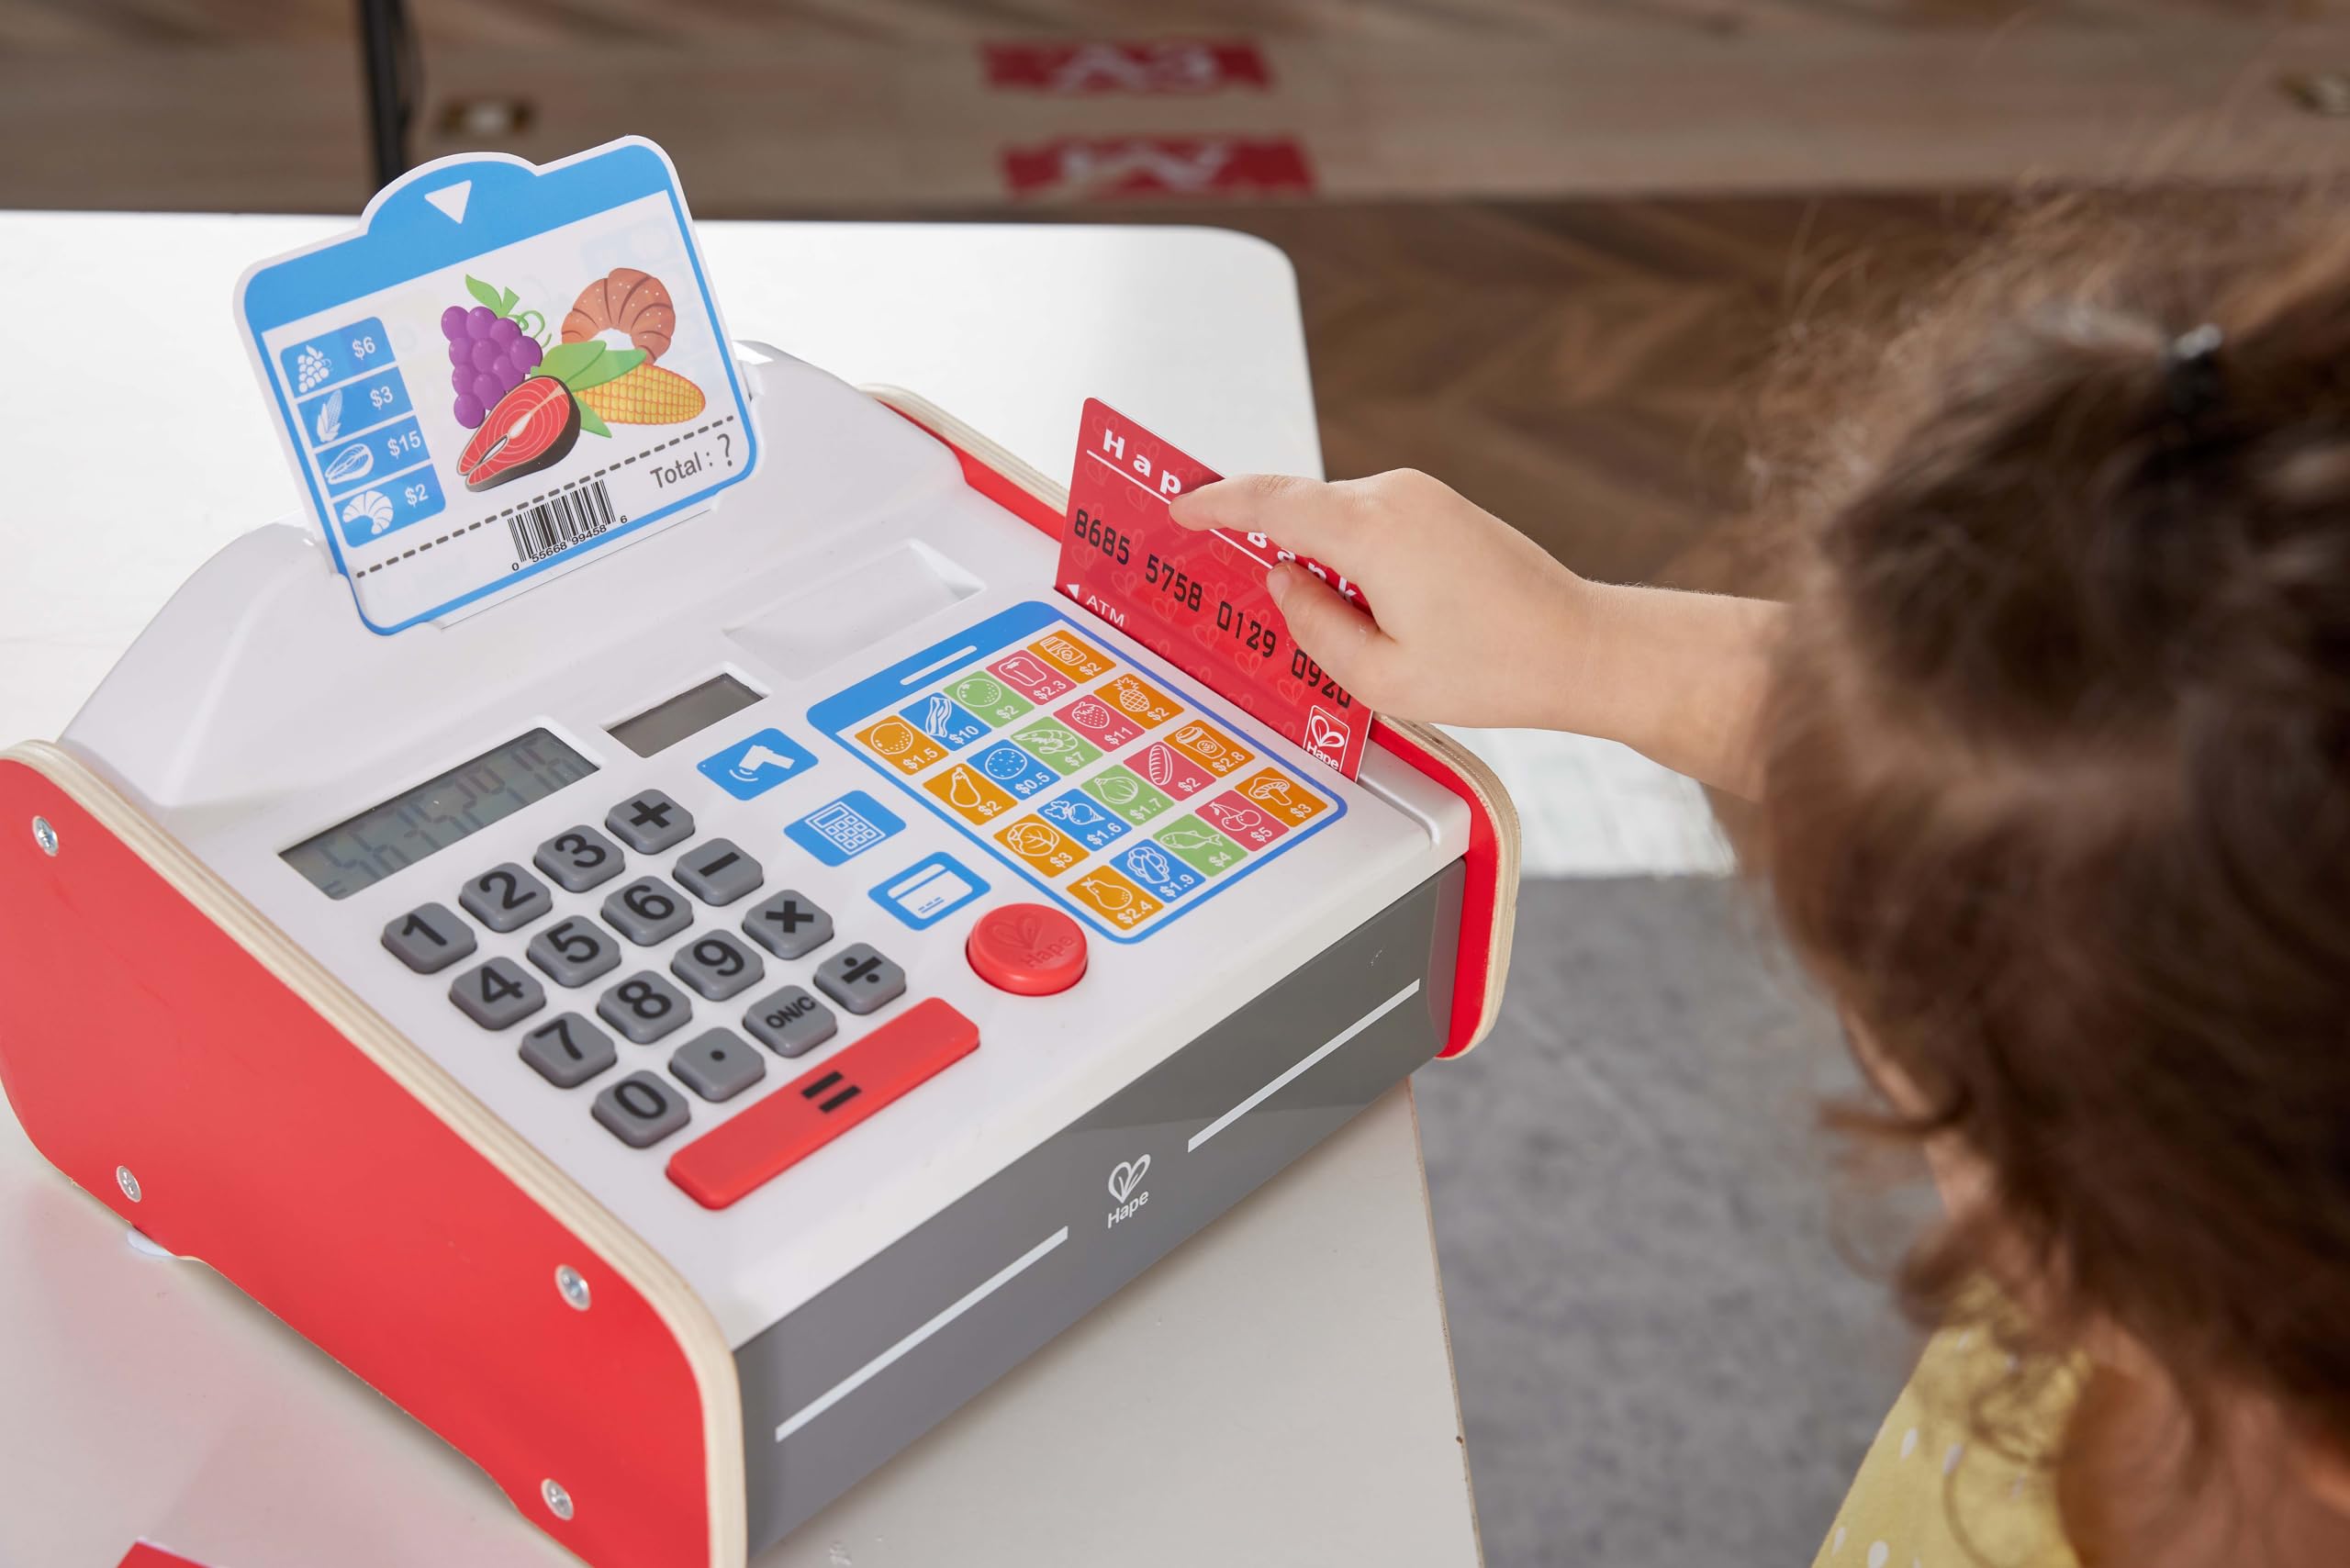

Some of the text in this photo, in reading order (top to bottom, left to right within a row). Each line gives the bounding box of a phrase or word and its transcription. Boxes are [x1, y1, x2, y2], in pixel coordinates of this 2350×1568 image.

[352, 336, 376, 361] $6
[370, 386, 394, 410] $3
[386, 431, 422, 460] $15
[649, 451, 703, 489] Total
[1102, 428, 1183, 495] Hap
[404, 483, 430, 508] $2
[531, 541, 568, 564] 55668
[570, 523, 608, 546] 99458
[620, 514, 629, 525] 6
[1073, 509, 1132, 566] 8685
[1145, 553, 1203, 613] 5758
[1216, 601, 1278, 659] 0129
[1086, 595, 1125, 628] ATM
[1079, 661, 1102, 677] $2
[1033, 679, 1067, 700] $2.3
[996, 705, 1020, 721] $2
[1147, 706, 1170, 722] $2
[948, 724, 980, 745] $10
[1103, 726, 1135, 745] $11
[902, 747, 939, 770] $1.5
[1064, 751, 1086, 767] $7
[1211, 751, 1246, 774] $2.8
[1014, 771, 1051, 795] $0.5
[1178, 777, 1202, 793] $2
[977, 800, 1002, 817] $2
[1129, 798, 1163, 821] $1.7
[1290, 803, 1313, 819] $3
[1086, 822, 1124, 846] $1.6
[1249, 826, 1273, 843] $5
[554, 833, 607, 869] 3
[1049, 851, 1074, 868] $3
[1208, 852, 1233, 868] $4
[478, 869, 537, 912] 2
[1158, 874, 1196, 898] $1.9
[622, 883, 675, 921] 6
[1116, 900, 1154, 925] $2.4
[401, 913, 448, 947] 1
[546, 922, 600, 964] 5
[692, 938, 745, 978] 9
[480, 966, 524, 1004] 4
[616, 980, 673, 1020] 8
[765, 995, 817, 1030] ON/C
[532, 1019, 584, 1062] 7
[612, 1080, 668, 1120] 0
[1107, 1191, 1149, 1229] Hape
